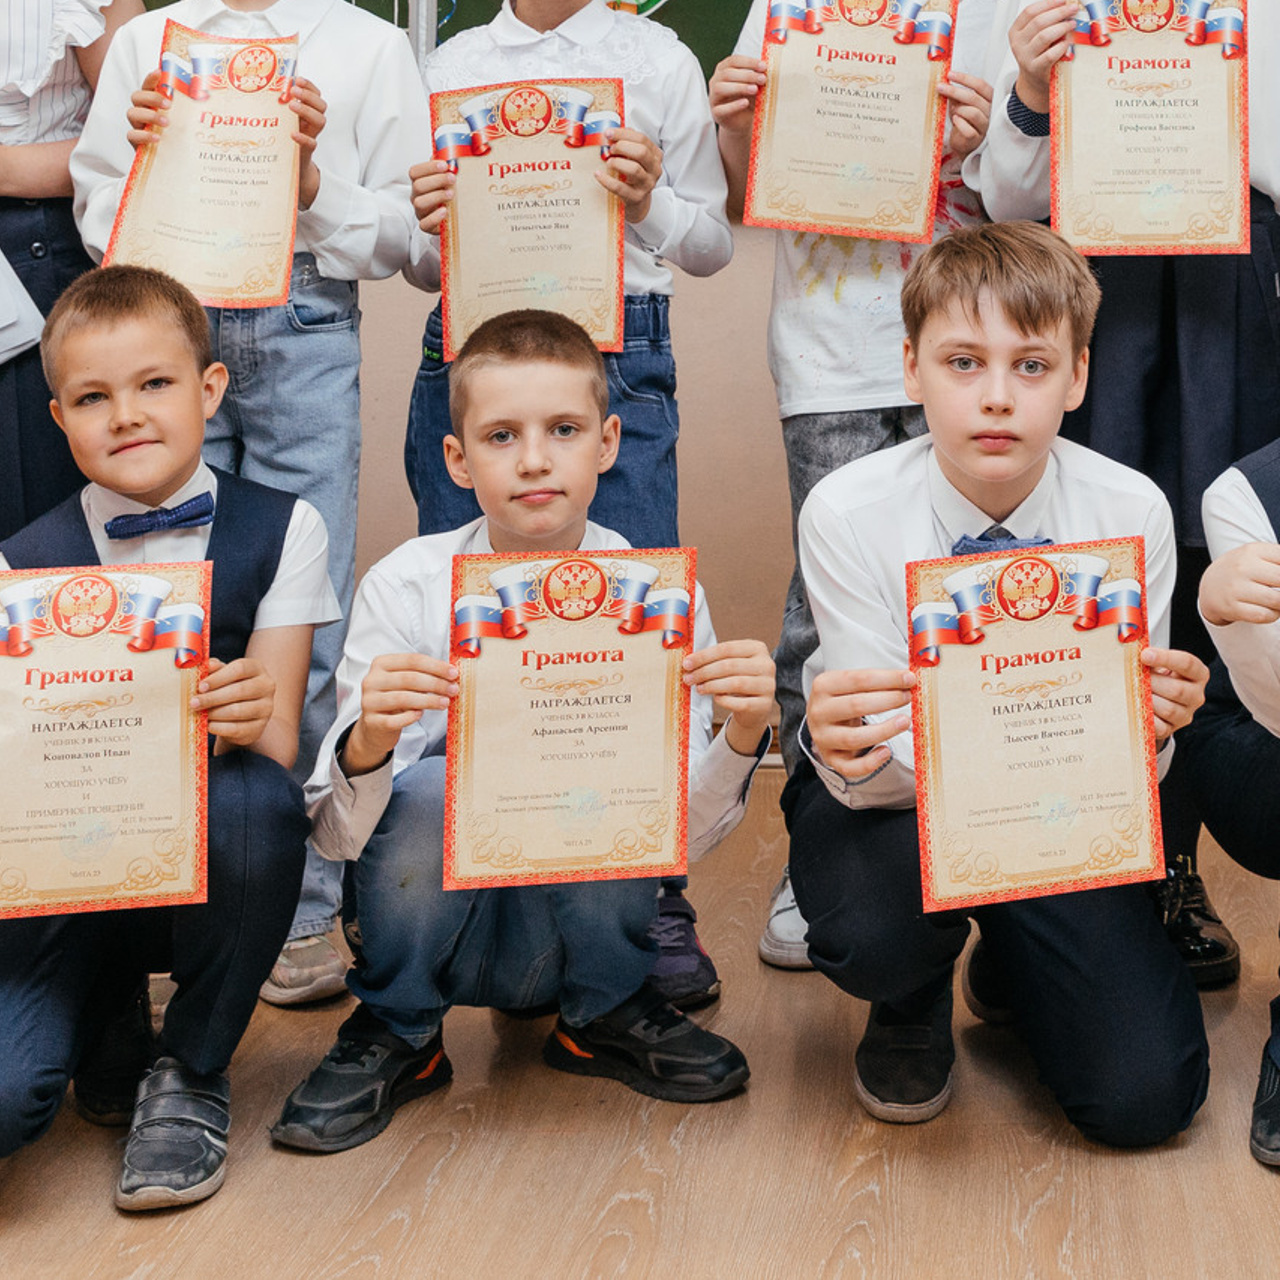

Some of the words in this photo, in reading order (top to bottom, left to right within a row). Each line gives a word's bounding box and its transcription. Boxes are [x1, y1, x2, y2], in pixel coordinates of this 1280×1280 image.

[817, 44, 897, 63] Грамота
[1107, 56, 1191, 74] Грамота
[821, 86, 900, 101] НАГРАЖДАЕТСЯ
[1115, 99, 1198, 107] НАГРАЖДАЕТСЯ
[200, 112, 279, 128] Грамота
[199, 152, 278, 162] НАГРАЖДАЕТСЯ
[488, 160, 571, 179] Грамота
[498, 199, 580, 211] НАГРАЖДАЕТСЯ
[521, 650, 624, 670] Грамота
[980, 646, 1081, 674] Грамота
[25, 668, 134, 690] Грамота
[530, 695, 631, 709] НАГРАЖДАЕТСЯ
[992, 694, 1091, 715] НАГРАЖДАЕТСЯ
[32, 717, 143, 733] НАГРАЖДАЕТСЯ
[104, 749, 130, 757] Иван
[540, 751, 588, 761] ХОРОШУЮ
[1007, 758, 1055, 771] ХОРОШУЮ
[45, 779, 98, 789] ХОРОШУЮ
